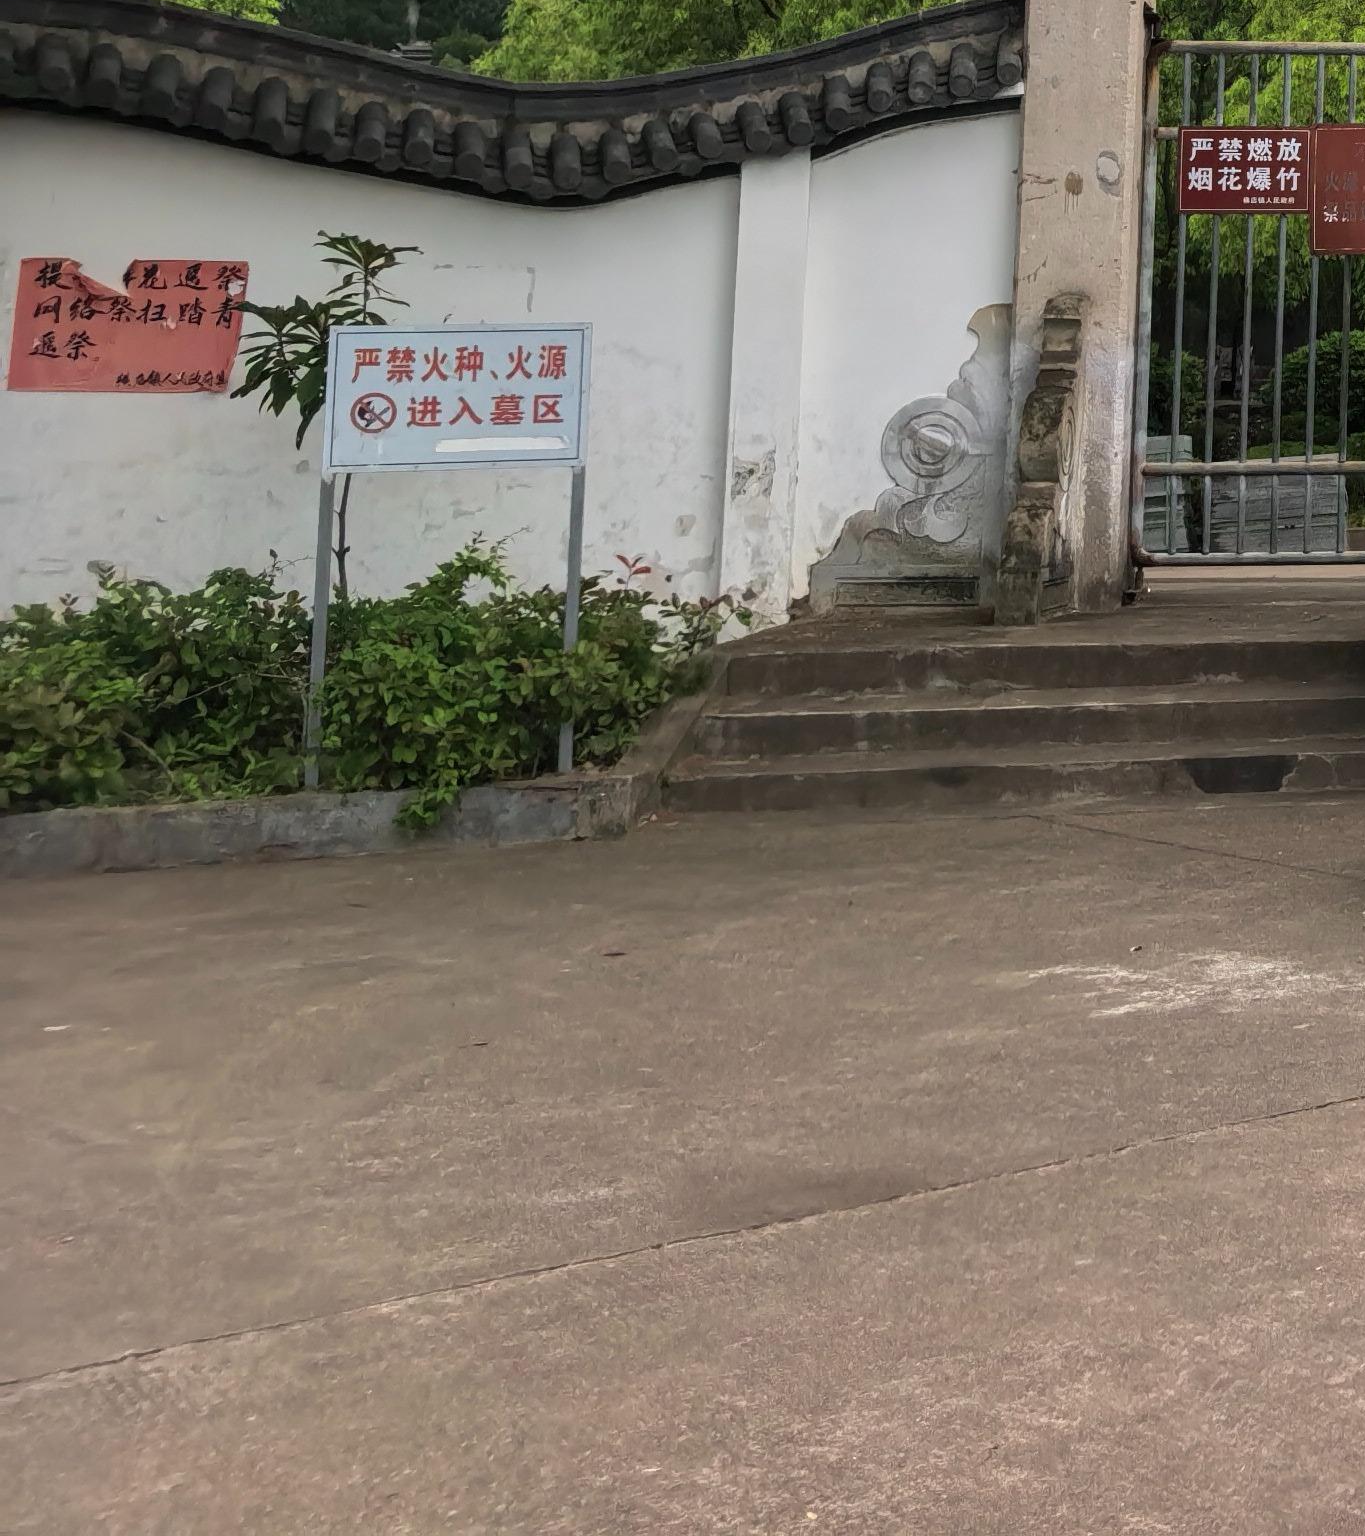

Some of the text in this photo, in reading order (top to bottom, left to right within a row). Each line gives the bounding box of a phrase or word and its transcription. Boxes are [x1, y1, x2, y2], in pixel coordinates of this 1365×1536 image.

[1189, 137, 1302, 162] 严禁燃放
[1187, 166, 1301, 192] 烟花爆竹
[352, 344, 568, 384] 严禁火种、火源
[407, 393, 565, 428] 进入墓区
